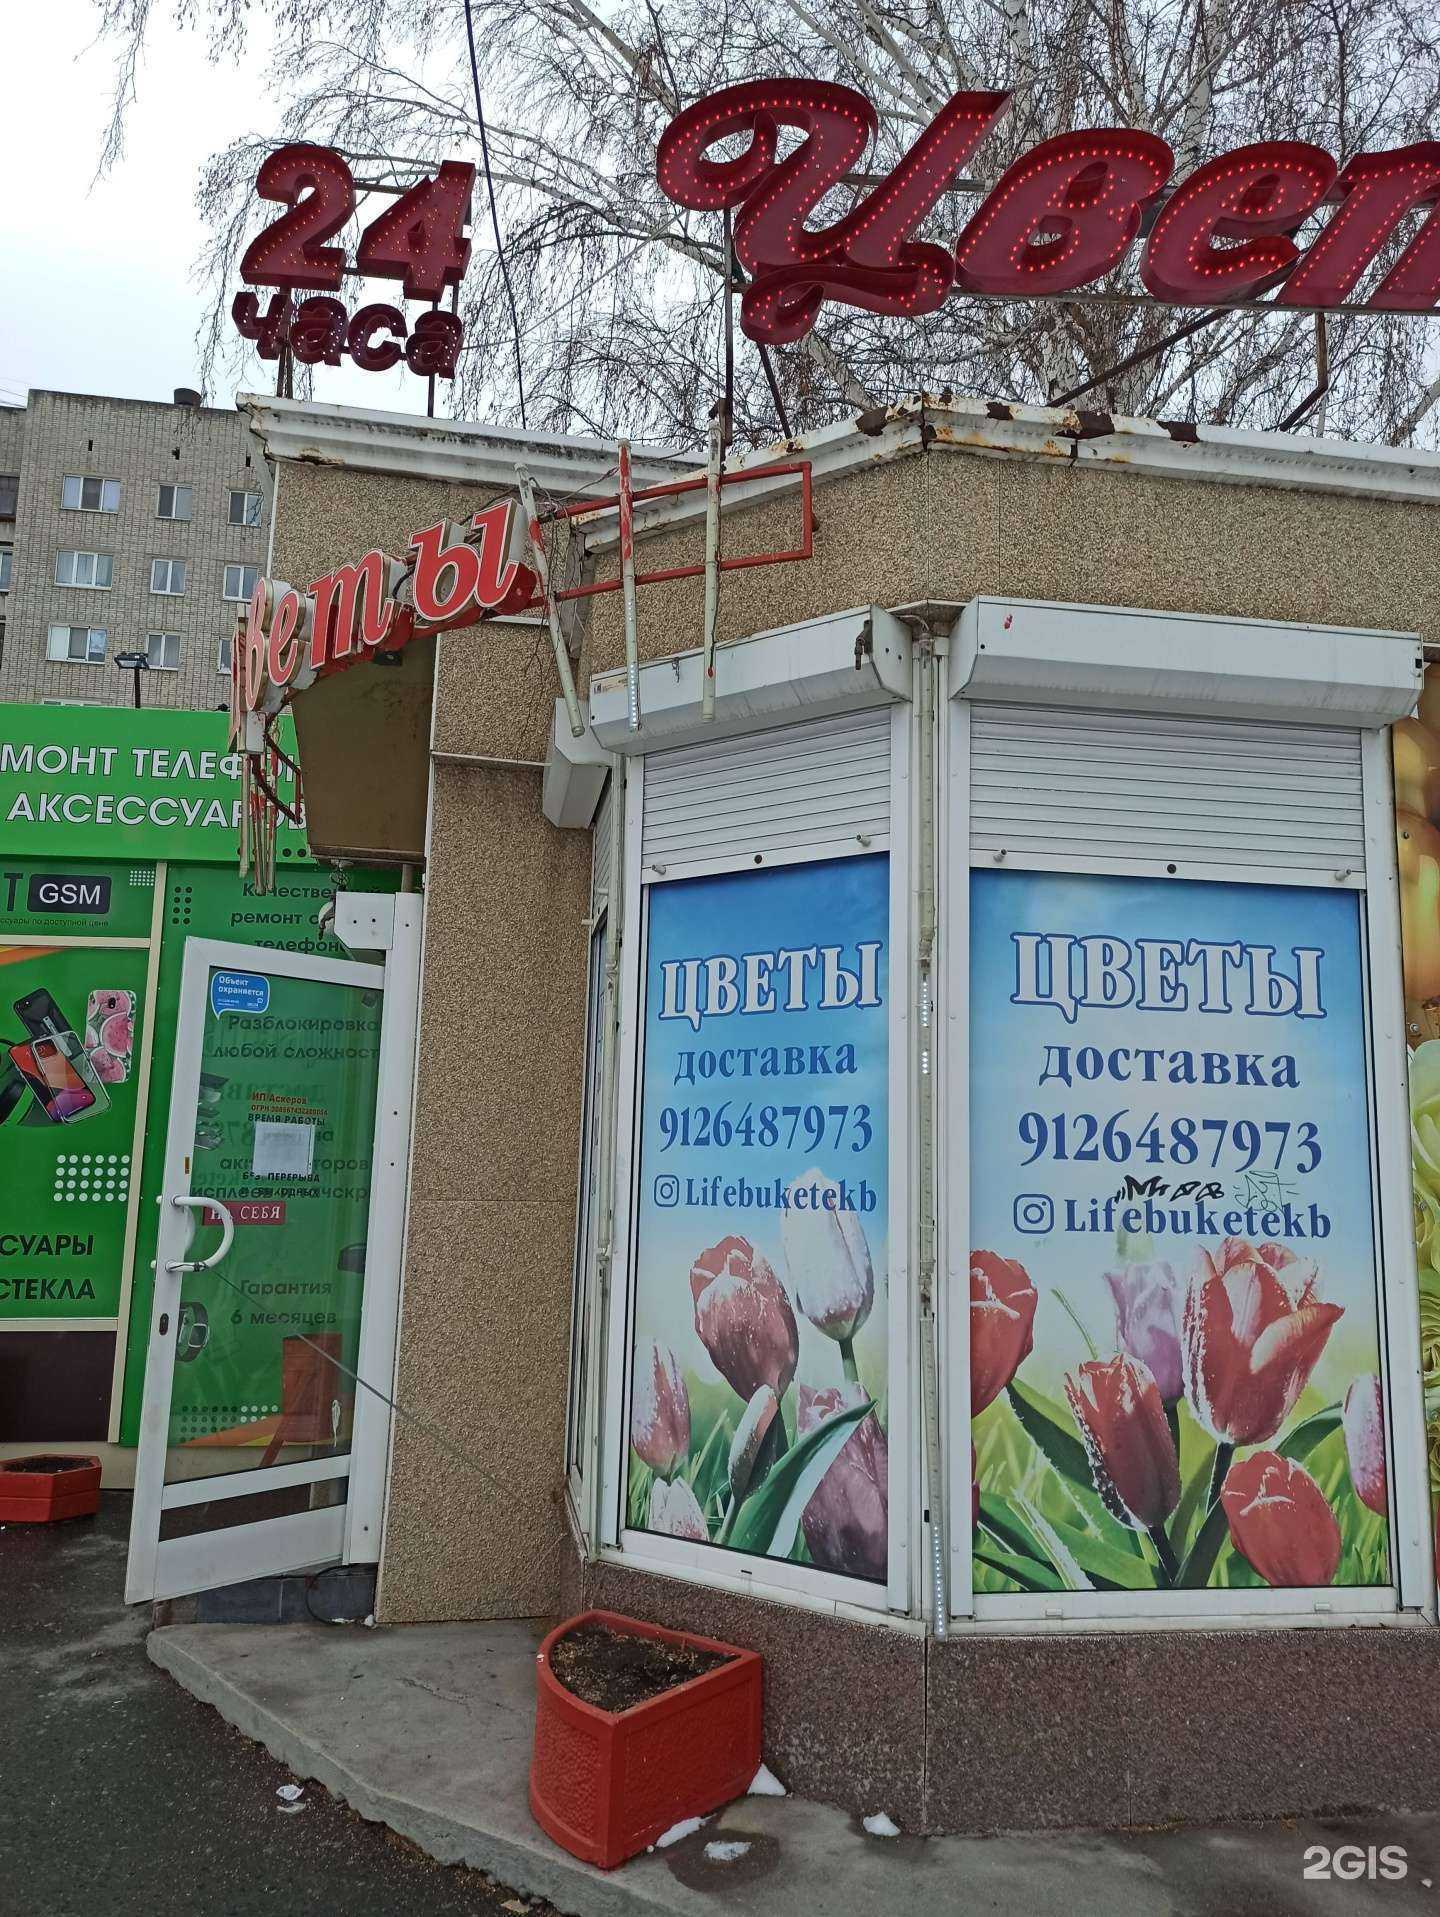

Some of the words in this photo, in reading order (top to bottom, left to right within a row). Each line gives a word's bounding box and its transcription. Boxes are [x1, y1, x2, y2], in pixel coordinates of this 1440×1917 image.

[240, 144, 475, 300] 24
[232, 291, 464, 379] часа
[39, 883, 101, 905] GSM
[230, 912, 302, 927] ремонт
[218, 986, 264, 998] охраняется
[219, 975, 249, 987] Объект
[658, 940, 883, 1033] ЦВЕТЫ
[1010, 931, 1328, 1024] ЦВЕТЫ
[214, 1043, 278, 1059] любой
[674, 1043, 858, 1087] доставка
[1038, 1045, 1301, 1088] доставка
[248, 1112, 280, 1123] ВРЕМЯ
[284, 1115, 325, 1127] РАБОТЫ
[659, 1100, 873, 1153] 9126487973
[1018, 1109, 1322, 1174] 9126487973
[685, 1175, 877, 1212] Lifebuketekb
[240, 1205, 281, 1220] СЕБЯ
[1064, 1198, 1332, 1238] Lifebuketekb
[240, 1280, 333, 1297] Гарантия
[230, 1309, 243, 1325] 6
[251, 1311, 337, 1326] месяцев
